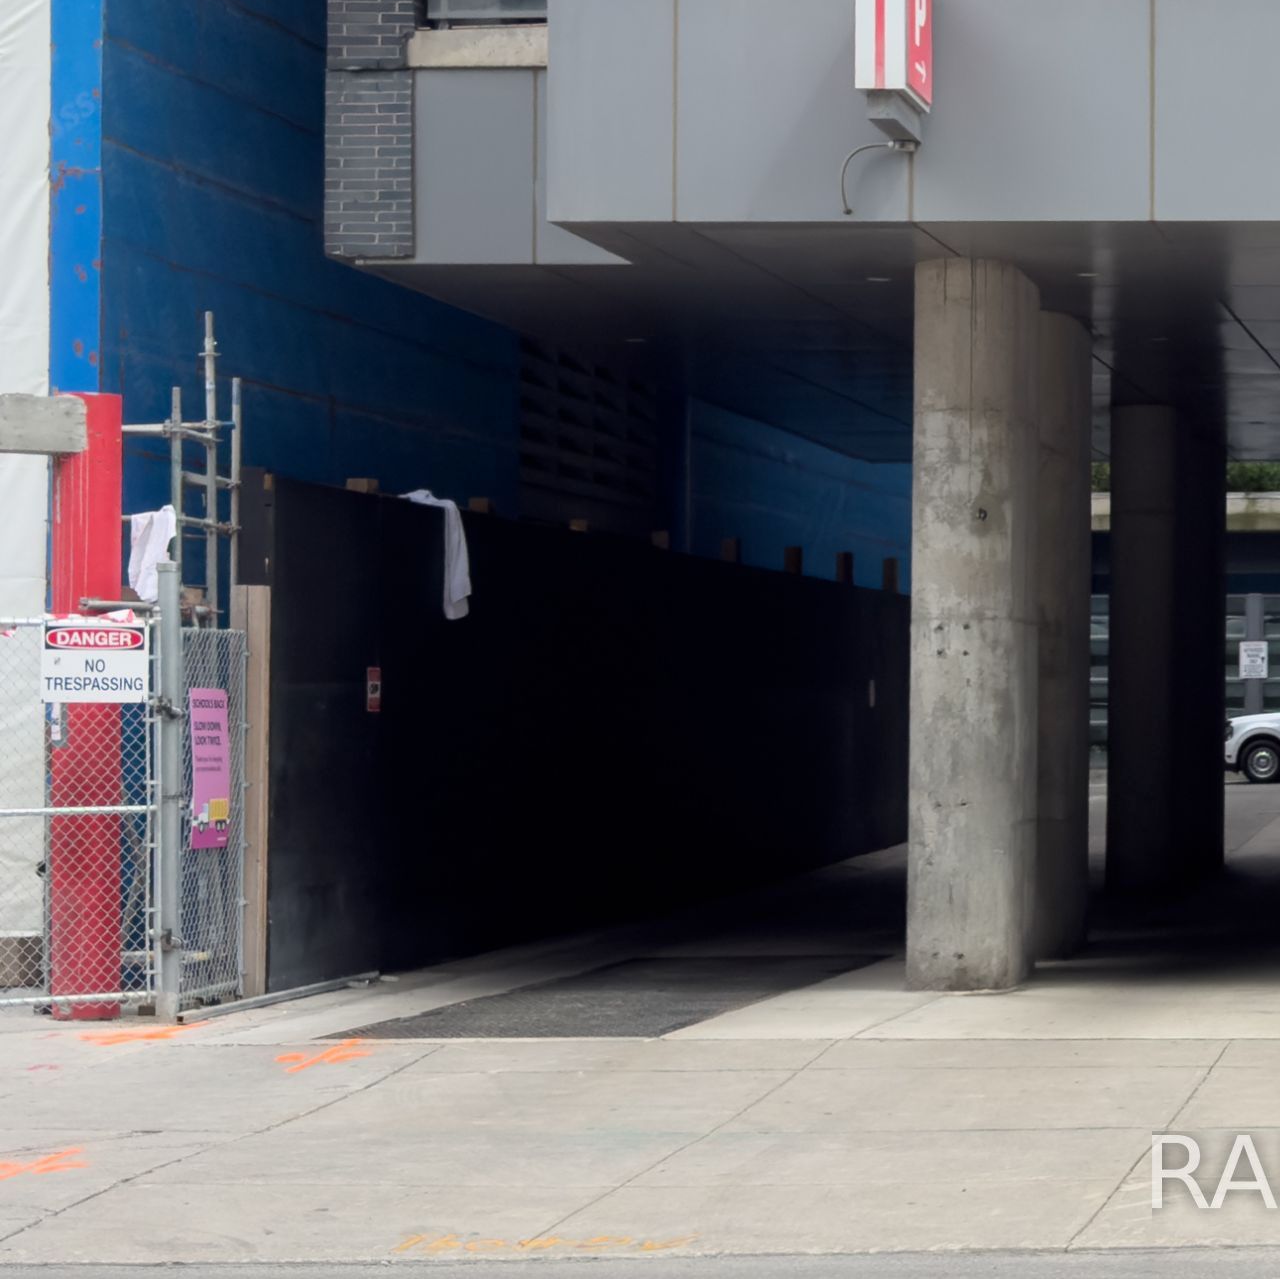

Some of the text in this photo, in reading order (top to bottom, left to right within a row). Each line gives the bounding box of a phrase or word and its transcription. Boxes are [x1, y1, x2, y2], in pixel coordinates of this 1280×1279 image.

[56, 631, 132, 646] DANGER
[84, 658, 106, 673] NO
[45, 677, 144, 691] TRESPASSING
